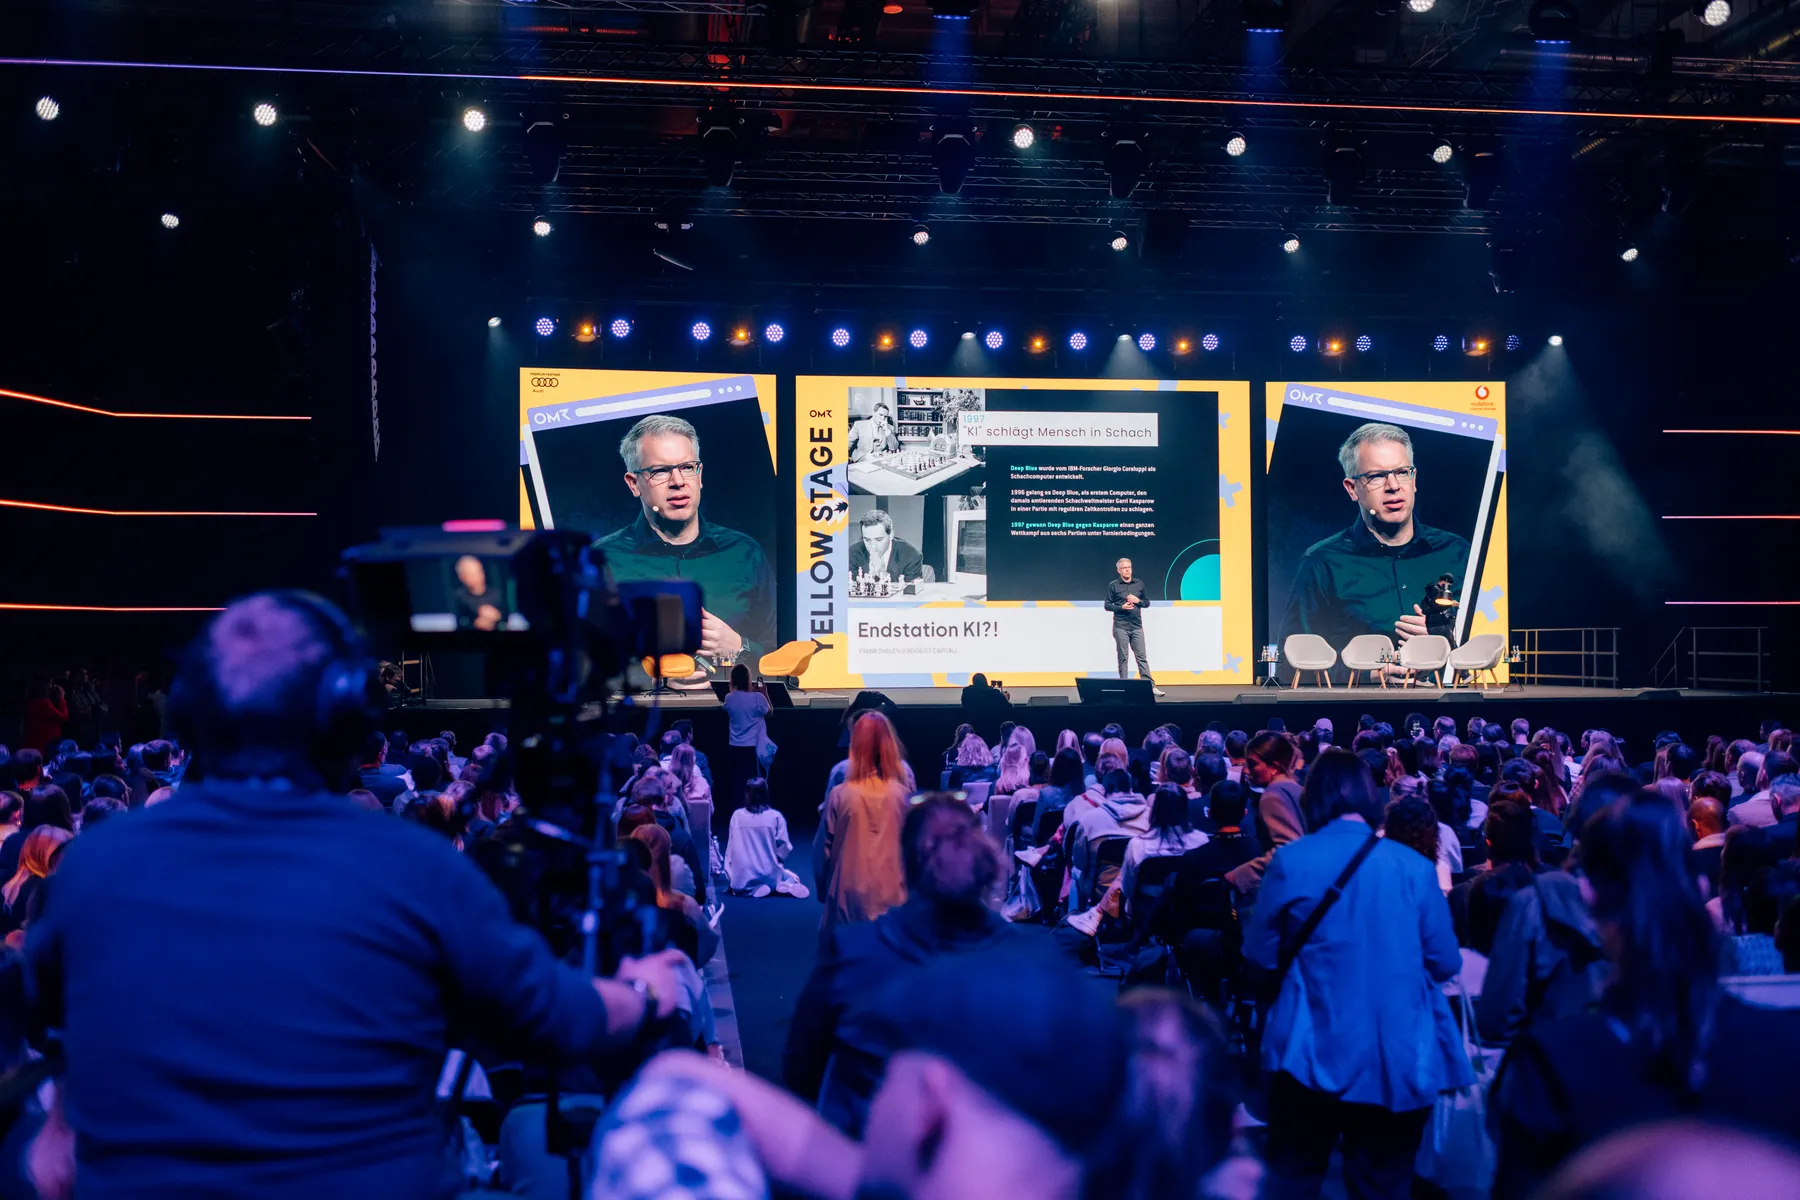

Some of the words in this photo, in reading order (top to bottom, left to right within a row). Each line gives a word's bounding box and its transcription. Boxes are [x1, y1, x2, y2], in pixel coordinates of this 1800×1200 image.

[963, 415, 985, 423] 1997
[986, 427, 1033, 440] schlägt
[1038, 427, 1086, 438] Mensch
[1090, 427, 1101, 438] in
[1105, 428, 1152, 438] Schach
[809, 427, 833, 522] STAGE
[810, 530, 834, 655] YELLOW
[858, 622, 959, 637] Endstation
[963, 621, 998, 637] KI?!
